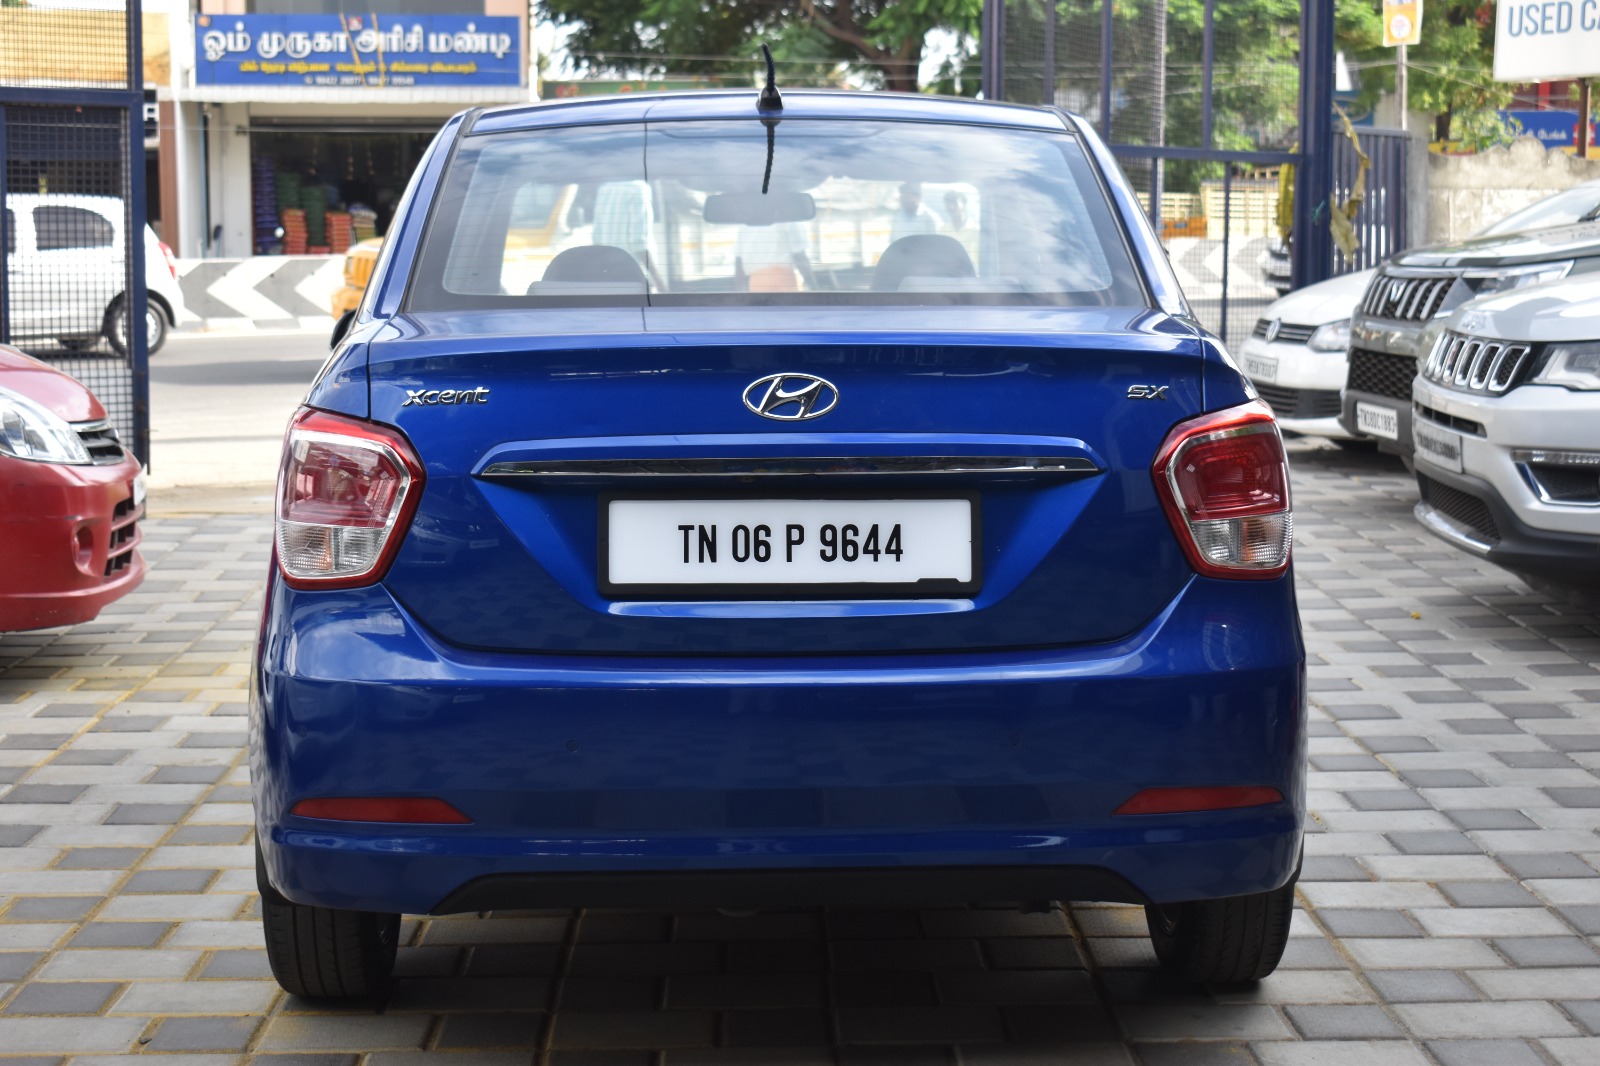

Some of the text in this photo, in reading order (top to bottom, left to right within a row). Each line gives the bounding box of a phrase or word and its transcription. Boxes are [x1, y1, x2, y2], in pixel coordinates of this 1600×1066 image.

[1508, 0, 1600, 38] USED C
[203, 21, 511, 61] ஓம் முருகா அரிசி மண்டி
[1127, 384, 1169, 400] SX
[678, 523, 904, 563] TN 06 P 9644
